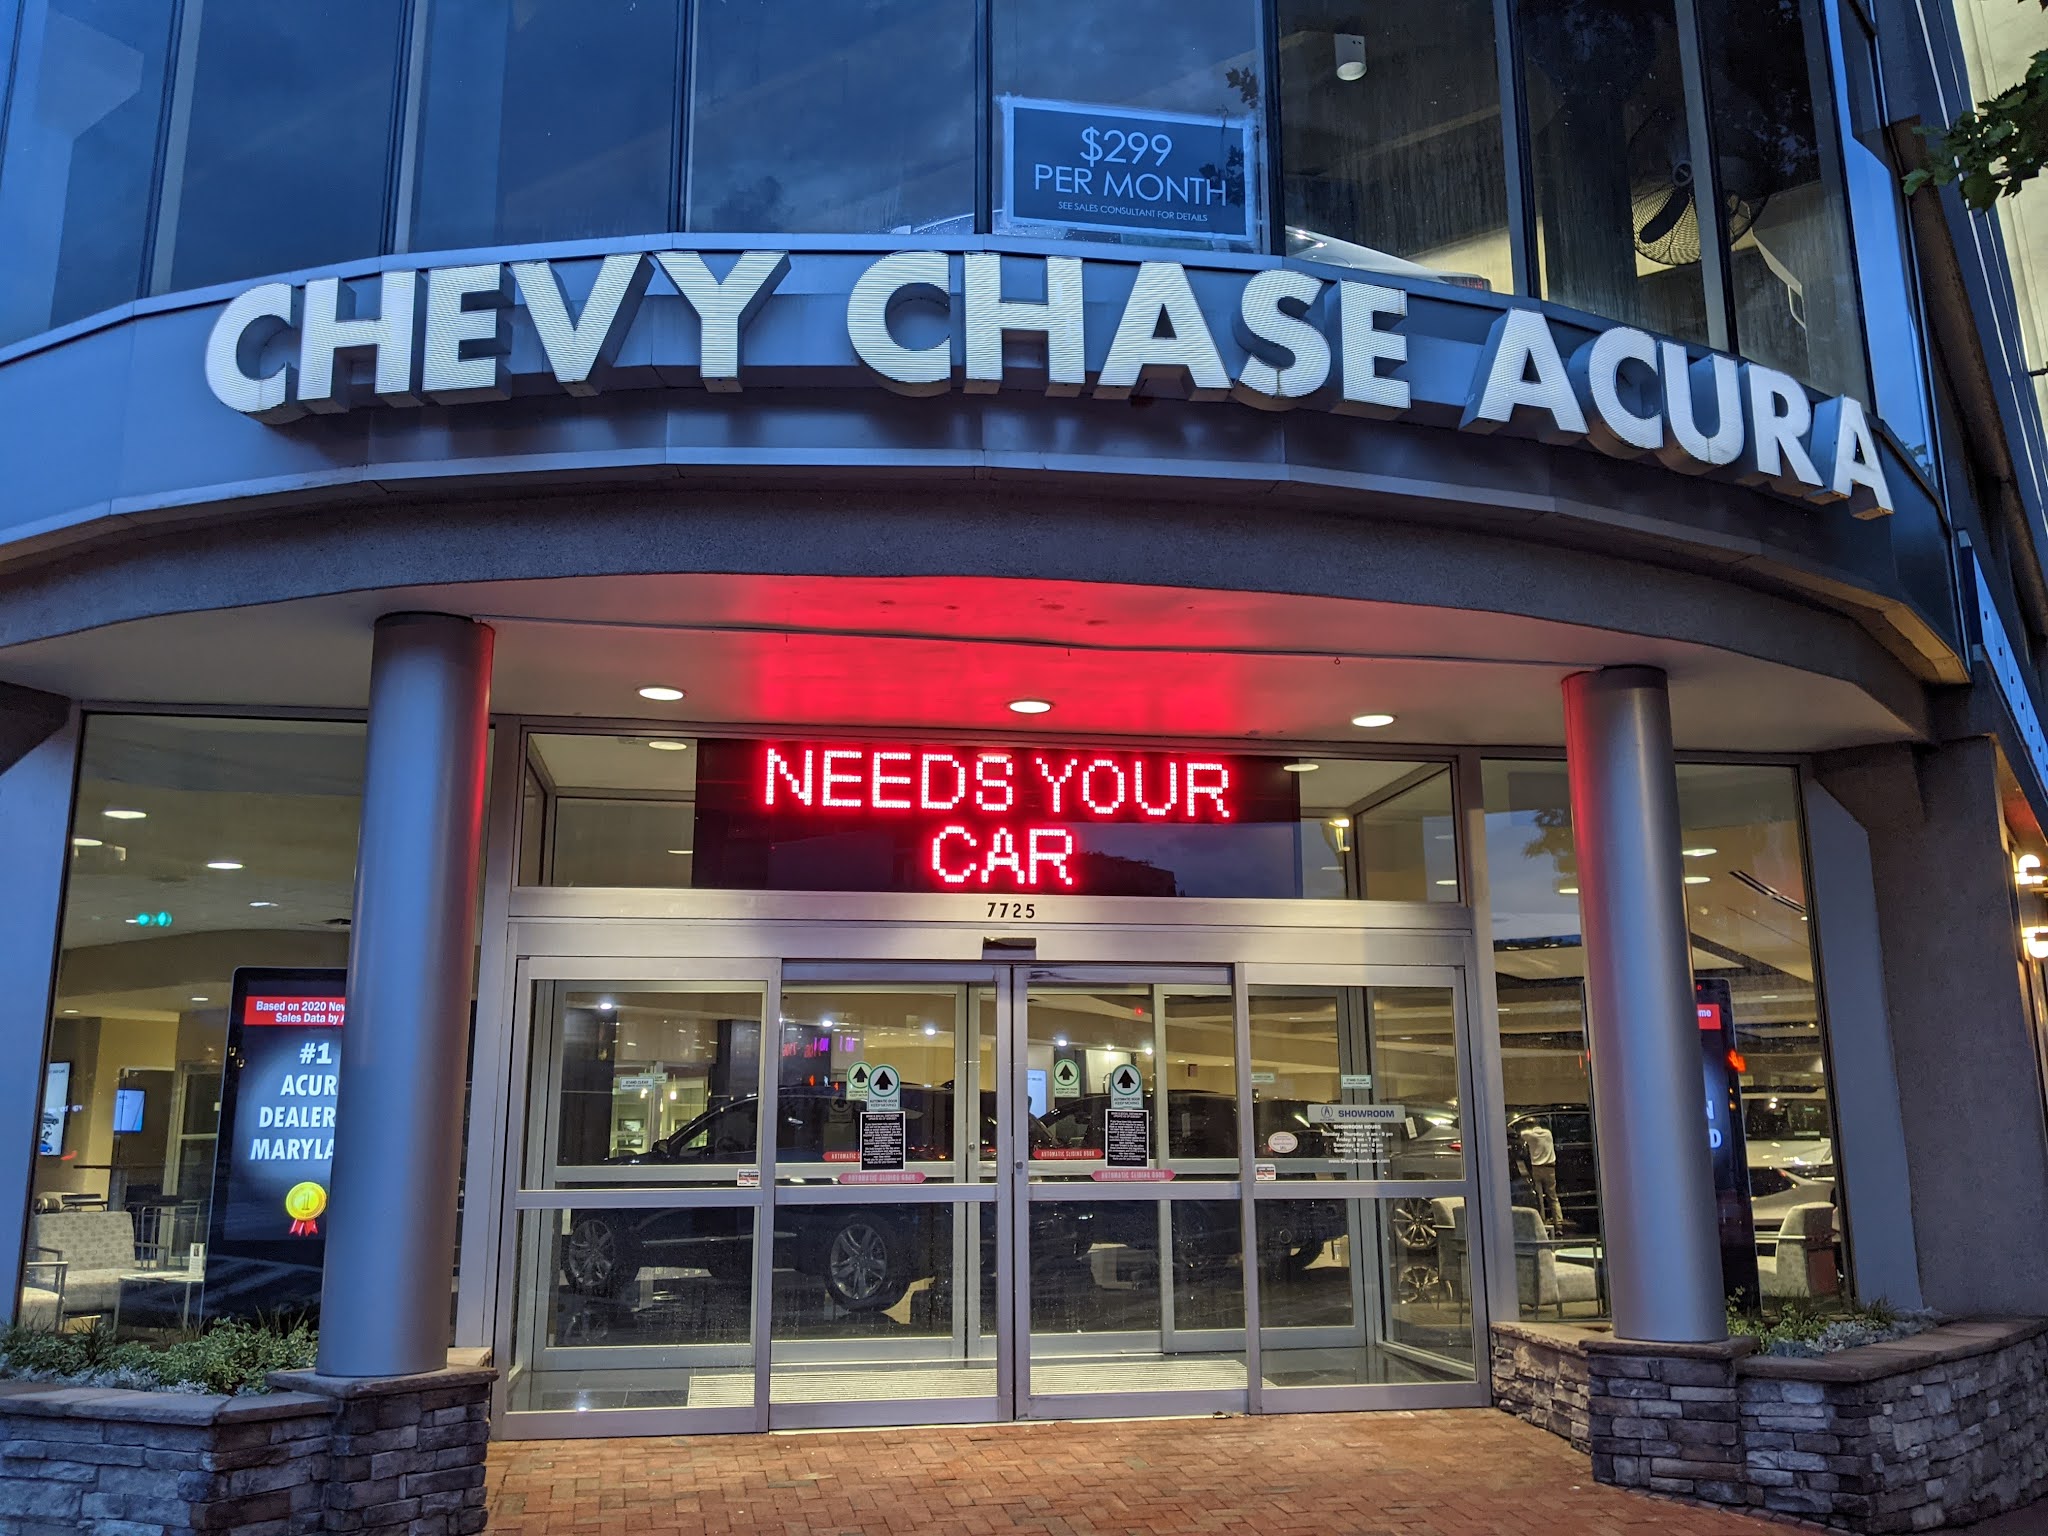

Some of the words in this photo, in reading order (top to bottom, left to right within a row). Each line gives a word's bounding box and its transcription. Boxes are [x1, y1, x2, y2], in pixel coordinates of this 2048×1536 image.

[1080, 126, 1173, 167] $299
[1035, 164, 1092, 195] PER
[1103, 171, 1227, 207] MONTH
[1058, 201, 1073, 210] SEE
[1074, 203, 1098, 213] SALES
[1100, 205, 1155, 217] CONSULTANT
[1157, 210, 1175, 220] FOR
[1176, 212, 1208, 222] DETAILS
[205, 250, 790, 415] CHEVY
[846, 250, 1412, 410] CHASE
[1474, 307, 1895, 515] ACURA
[764, 747, 1014, 812] NEEDS
[1035, 757, 1231, 819] YOUR
[931, 825, 1073, 886] CAR
[986, 902, 1036, 919] 7725
[256, 1000, 285, 1011] Based
[287, 1003, 299, 1011] on
[301, 1001, 326, 1012] 2020
[275, 1012, 301, 1023] Sales
[303, 1013, 326, 1023] Data
[328, 1013, 339, 1026] by
[299, 1042, 332, 1065] #1
[258, 1106, 336, 1128] DEALER
[1338, 1110, 1395, 1118] SHOWROOM
[848, 1174, 878, 1182] AUTOMATIC
[1101, 1171, 1129, 1179] AUTOMATIC
[1130, 1171, 1151, 1179] SLIDING
